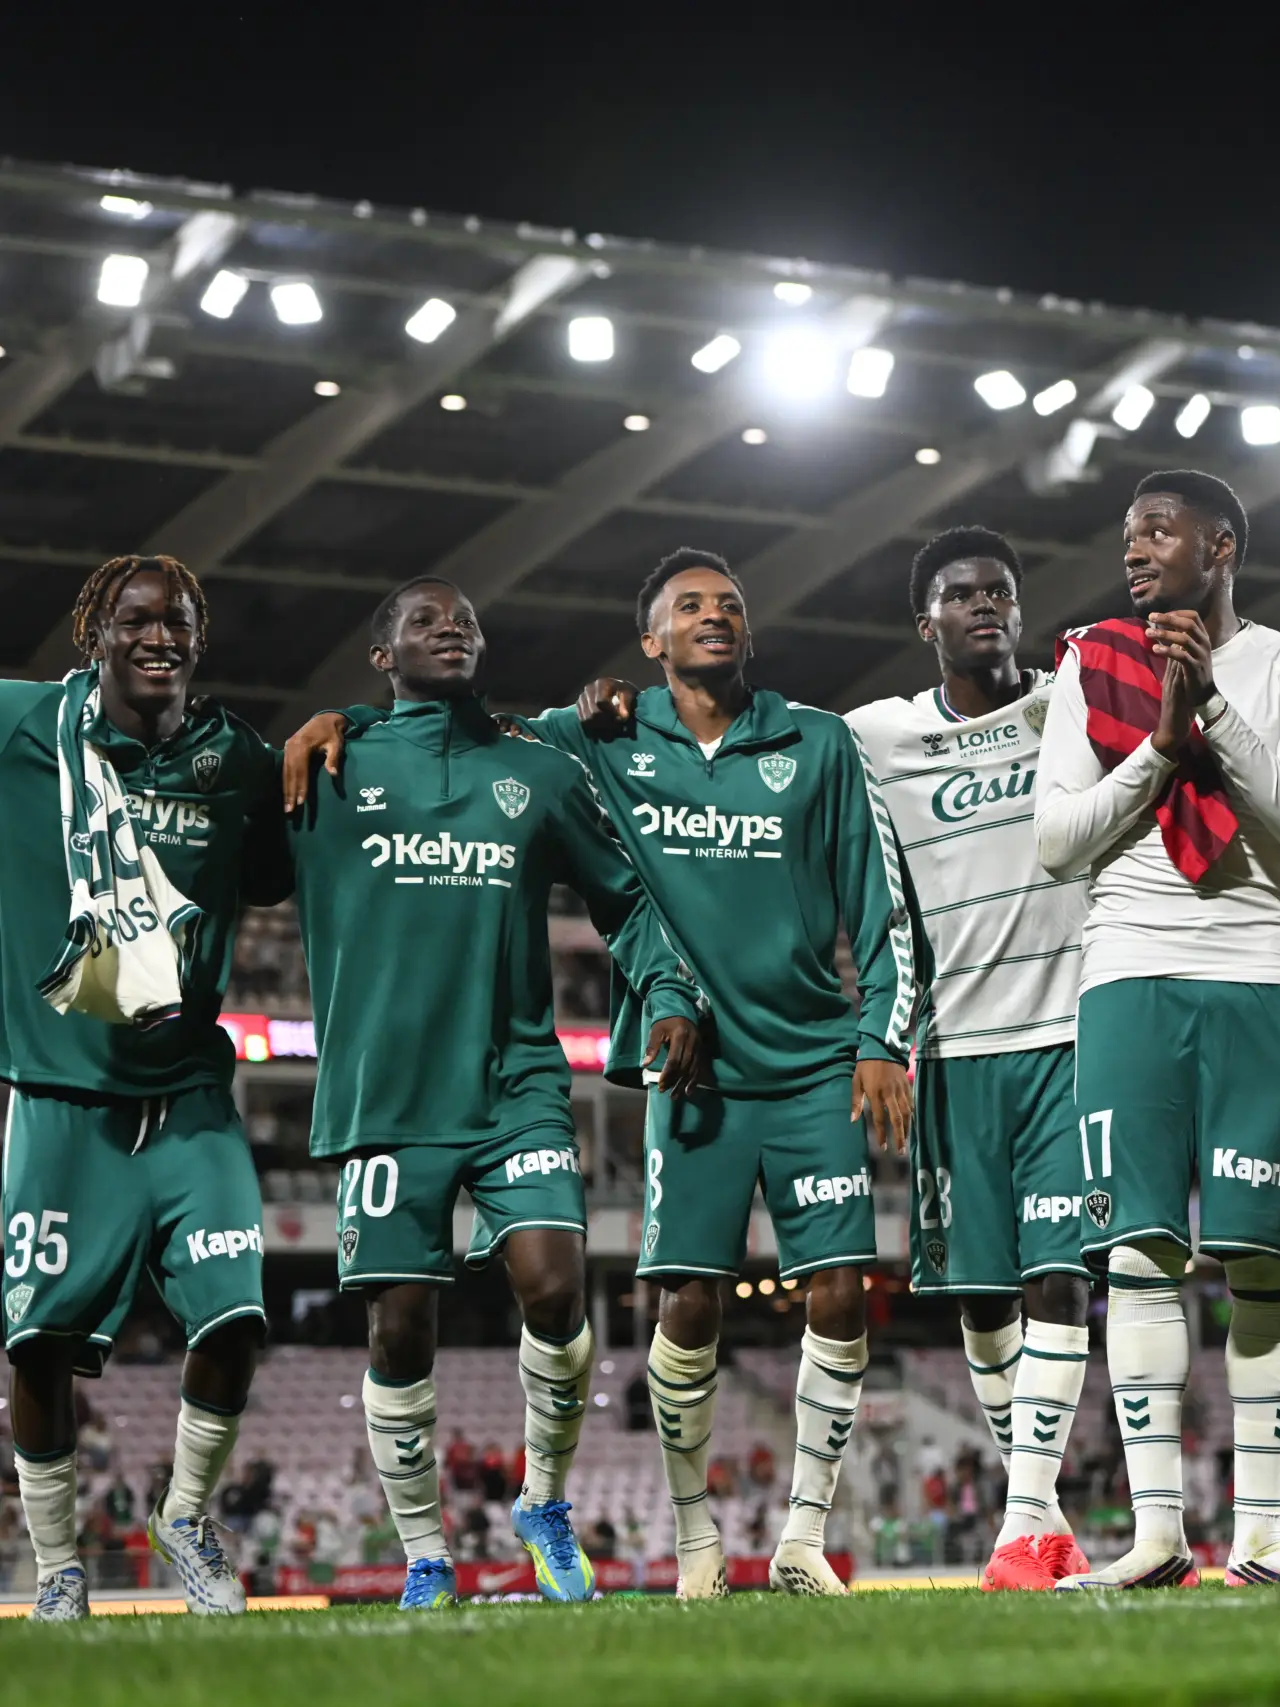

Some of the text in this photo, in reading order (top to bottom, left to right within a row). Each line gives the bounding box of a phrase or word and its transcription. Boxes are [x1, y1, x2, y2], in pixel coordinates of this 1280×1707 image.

[1027, 705, 1047, 718] ASS
[956, 724, 1019, 751] Loire
[924, 746, 951, 759] hummel
[970, 739, 1021, 757] DÉPARTEMENT
[196, 757, 218, 769] ASSE
[764, 759, 791, 770] ASSE
[627, 768, 656, 778] hummel
[499, 784, 525, 797] ASSE
[931, 762, 1038, 823] Casin
[356, 802, 387, 813] hummel
[661, 805, 784, 847] Kelyps
[143, 830, 183, 846] TERIM
[392, 831, 517, 875] Kelyps
[695, 847, 749, 860] INTERIM
[428, 875, 484, 887] INTERIM
[1078, 1108, 1114, 1181] 17
[505, 1146, 582, 1184] Kapri
[343, 1154, 399, 1218] 20
[792, 1166, 872, 1208] Kapri
[1023, 1192, 1083, 1224] Kapr
[1088, 1196, 1108, 1207] ASSE
[4, 1209, 69, 1278] 35
[186, 1223, 264, 1265] Kapri
